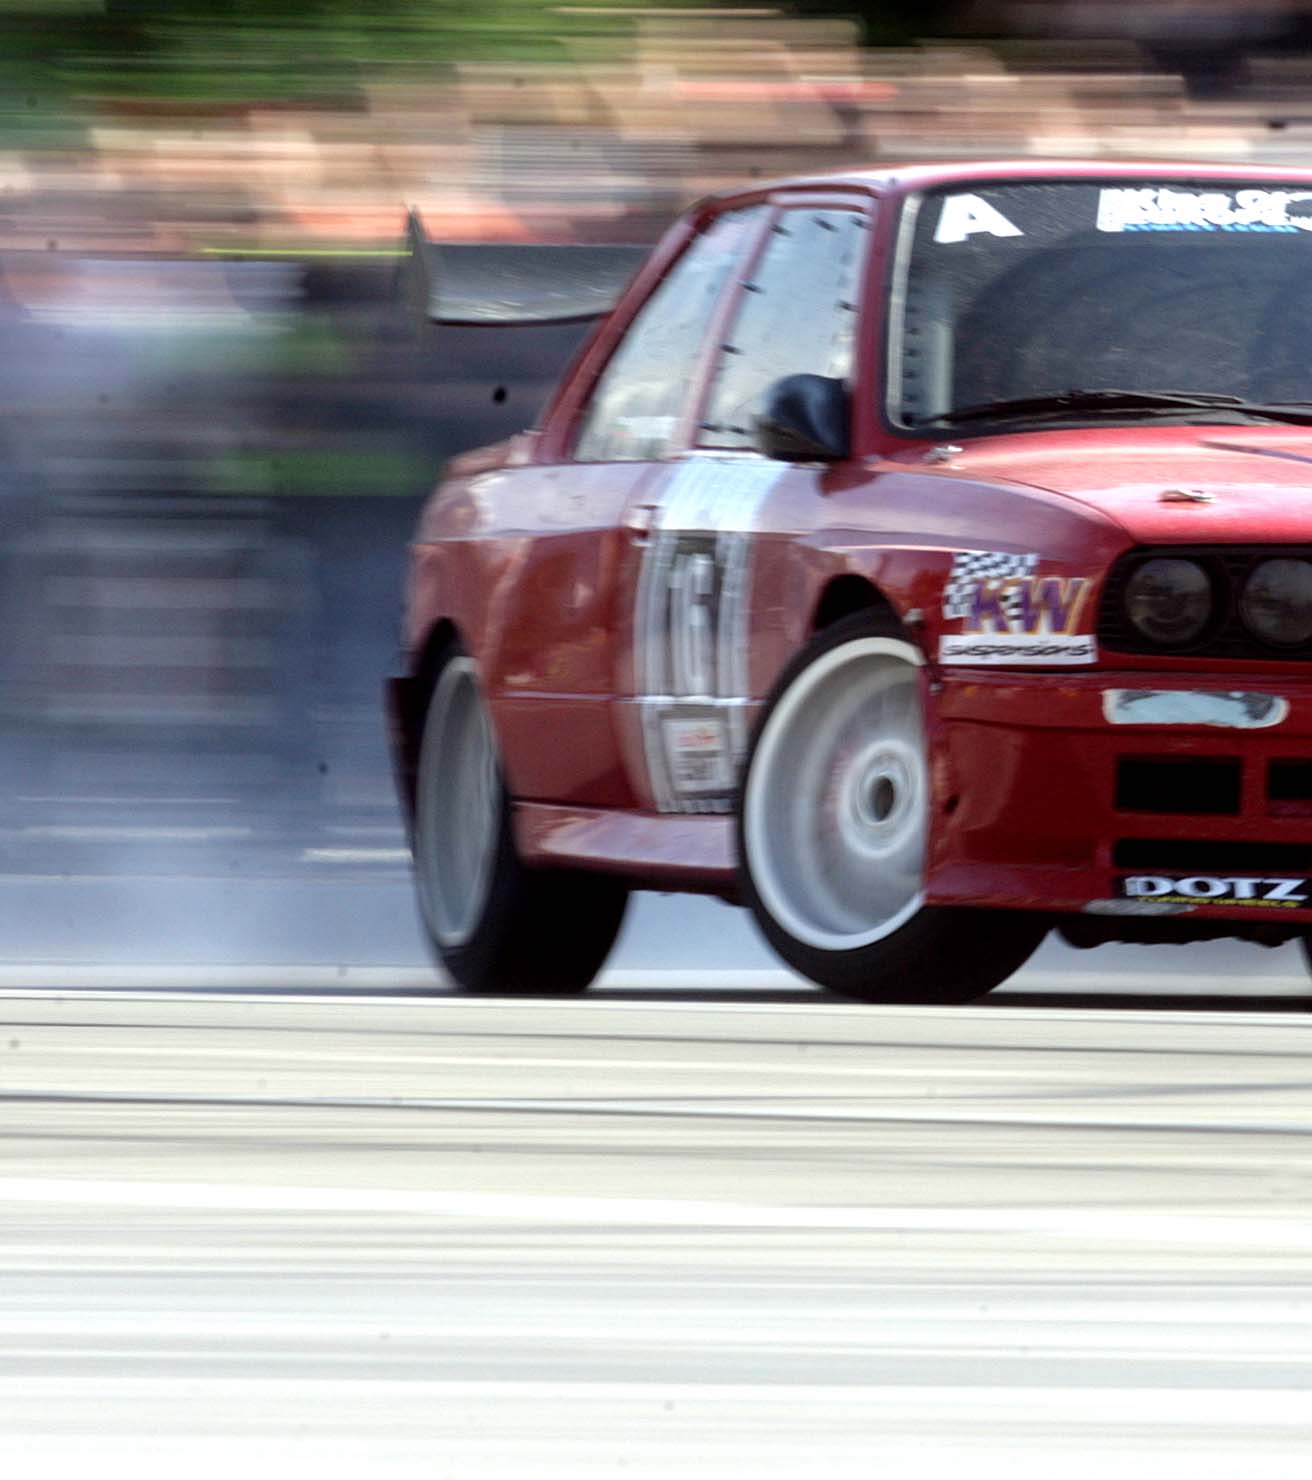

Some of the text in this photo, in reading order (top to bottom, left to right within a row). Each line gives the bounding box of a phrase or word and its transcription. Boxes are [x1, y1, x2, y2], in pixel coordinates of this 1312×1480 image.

[934, 193, 1024, 243] A
[962, 577, 1092, 634] KW
[1125, 876, 1308, 900] DOTZ
